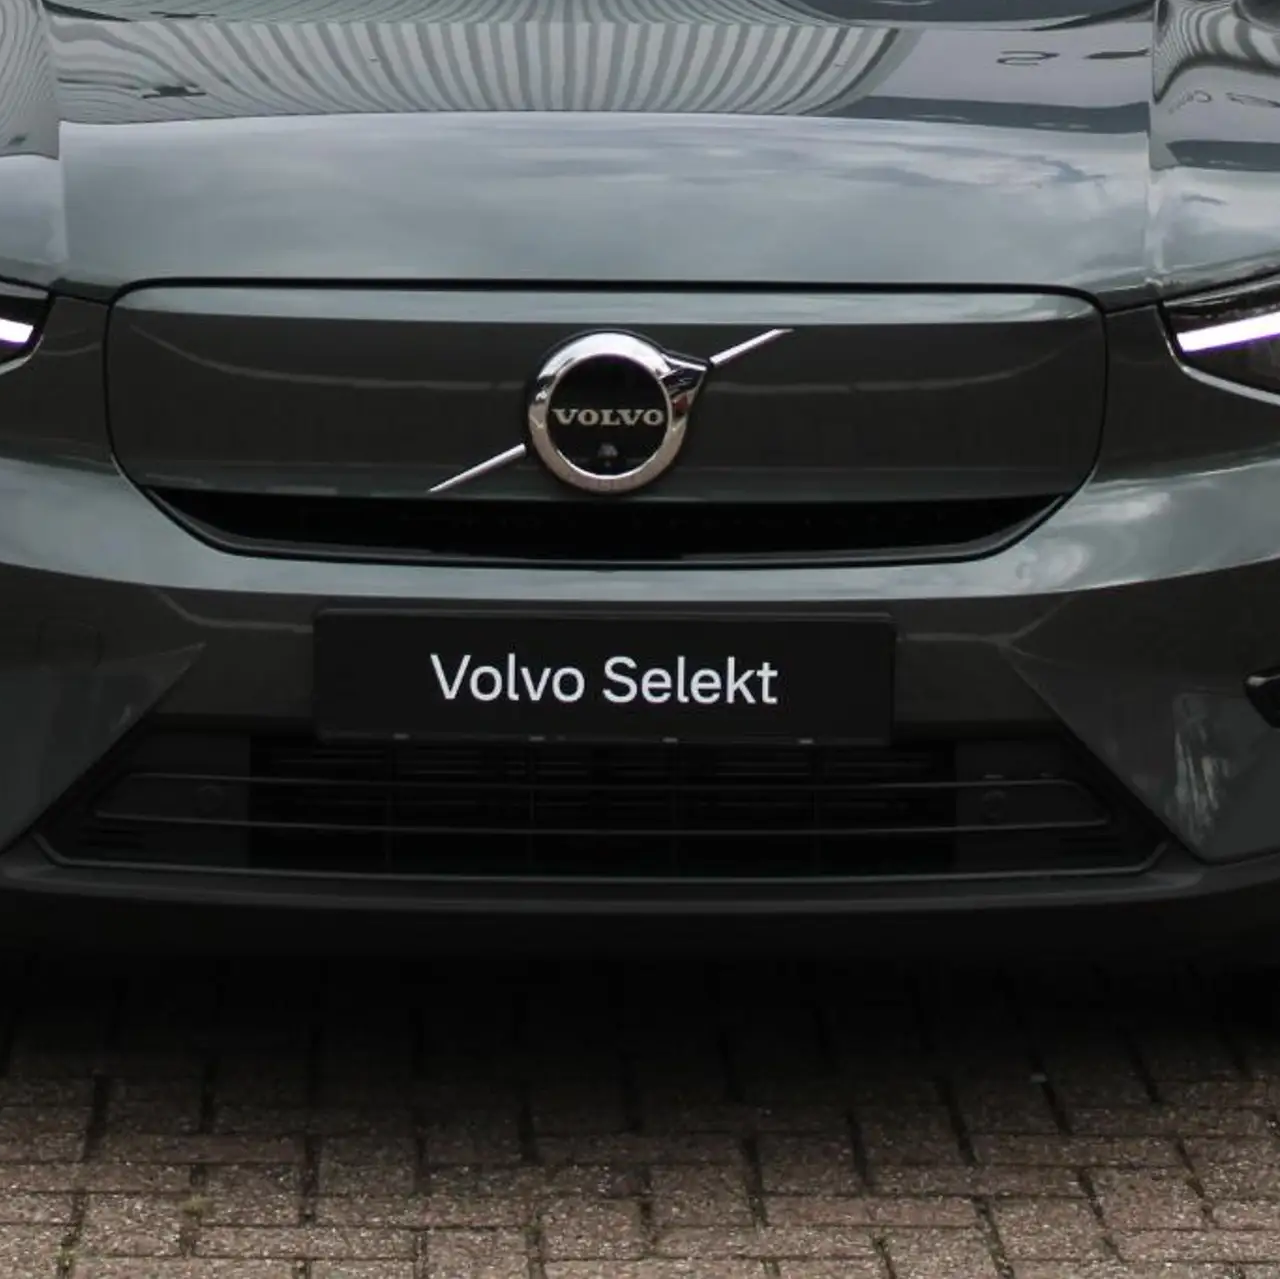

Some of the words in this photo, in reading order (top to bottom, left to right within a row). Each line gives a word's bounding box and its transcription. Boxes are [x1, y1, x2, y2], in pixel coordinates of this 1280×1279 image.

[552, 407, 665, 428] VOLVO
[429, 652, 586, 704] Volvo
[601, 654, 780, 706] Selekt
